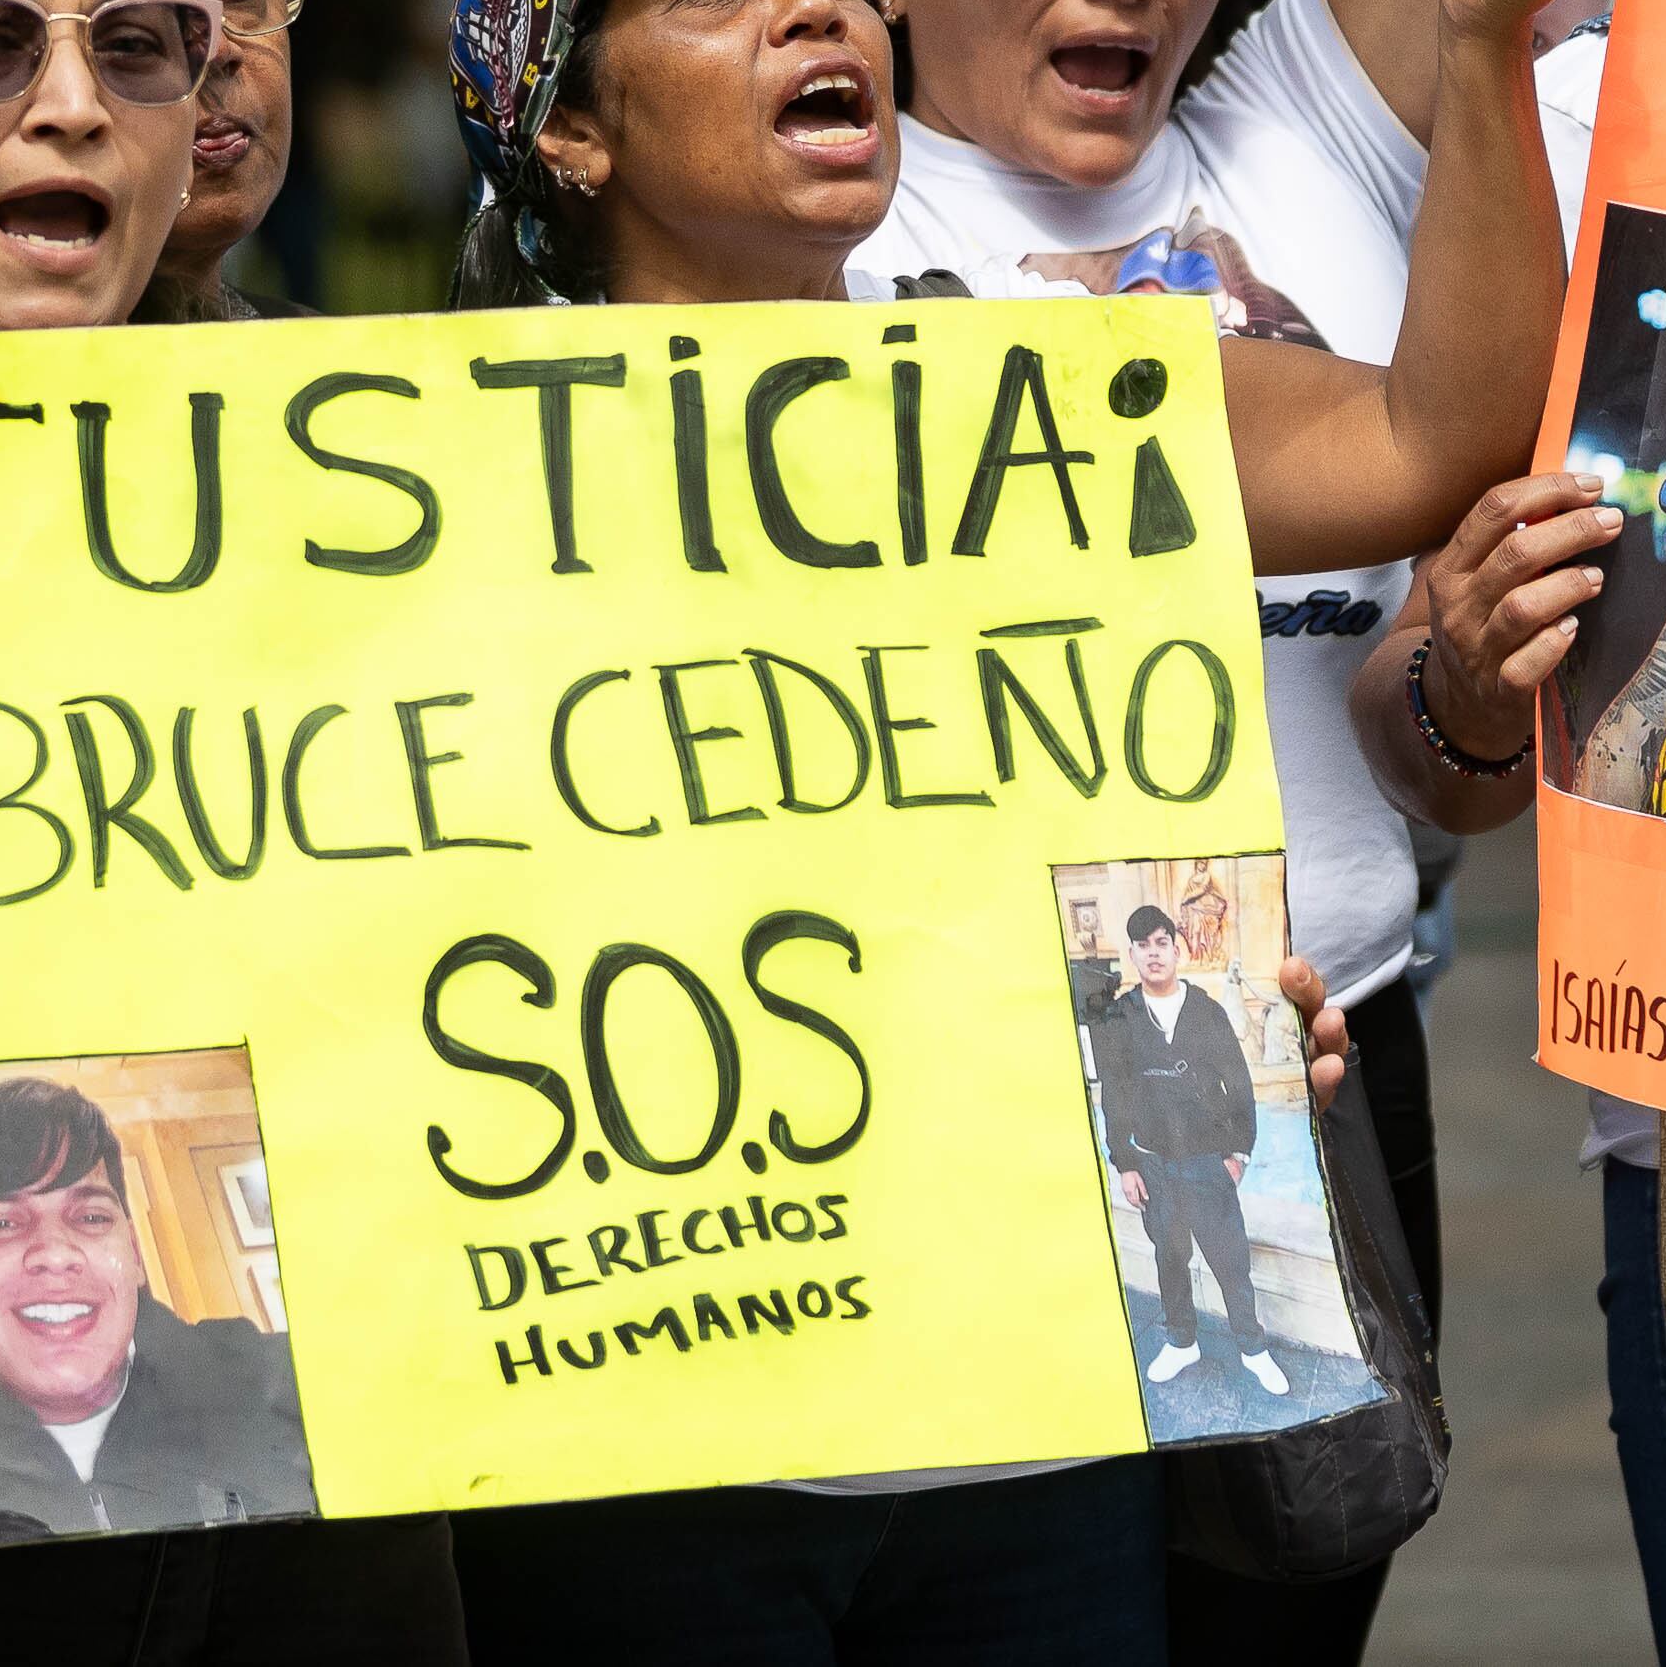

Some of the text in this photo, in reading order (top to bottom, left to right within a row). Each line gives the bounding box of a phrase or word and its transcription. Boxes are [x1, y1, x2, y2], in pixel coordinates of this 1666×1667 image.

[1255, 588, 1383, 638] eña
[549, 616, 1237, 837] CEDEÑO
[422, 908, 872, 1201] S.O.S
[464, 1194, 849, 1312] DERECHOS
[495, 1276, 873, 1385] HUMANOS
